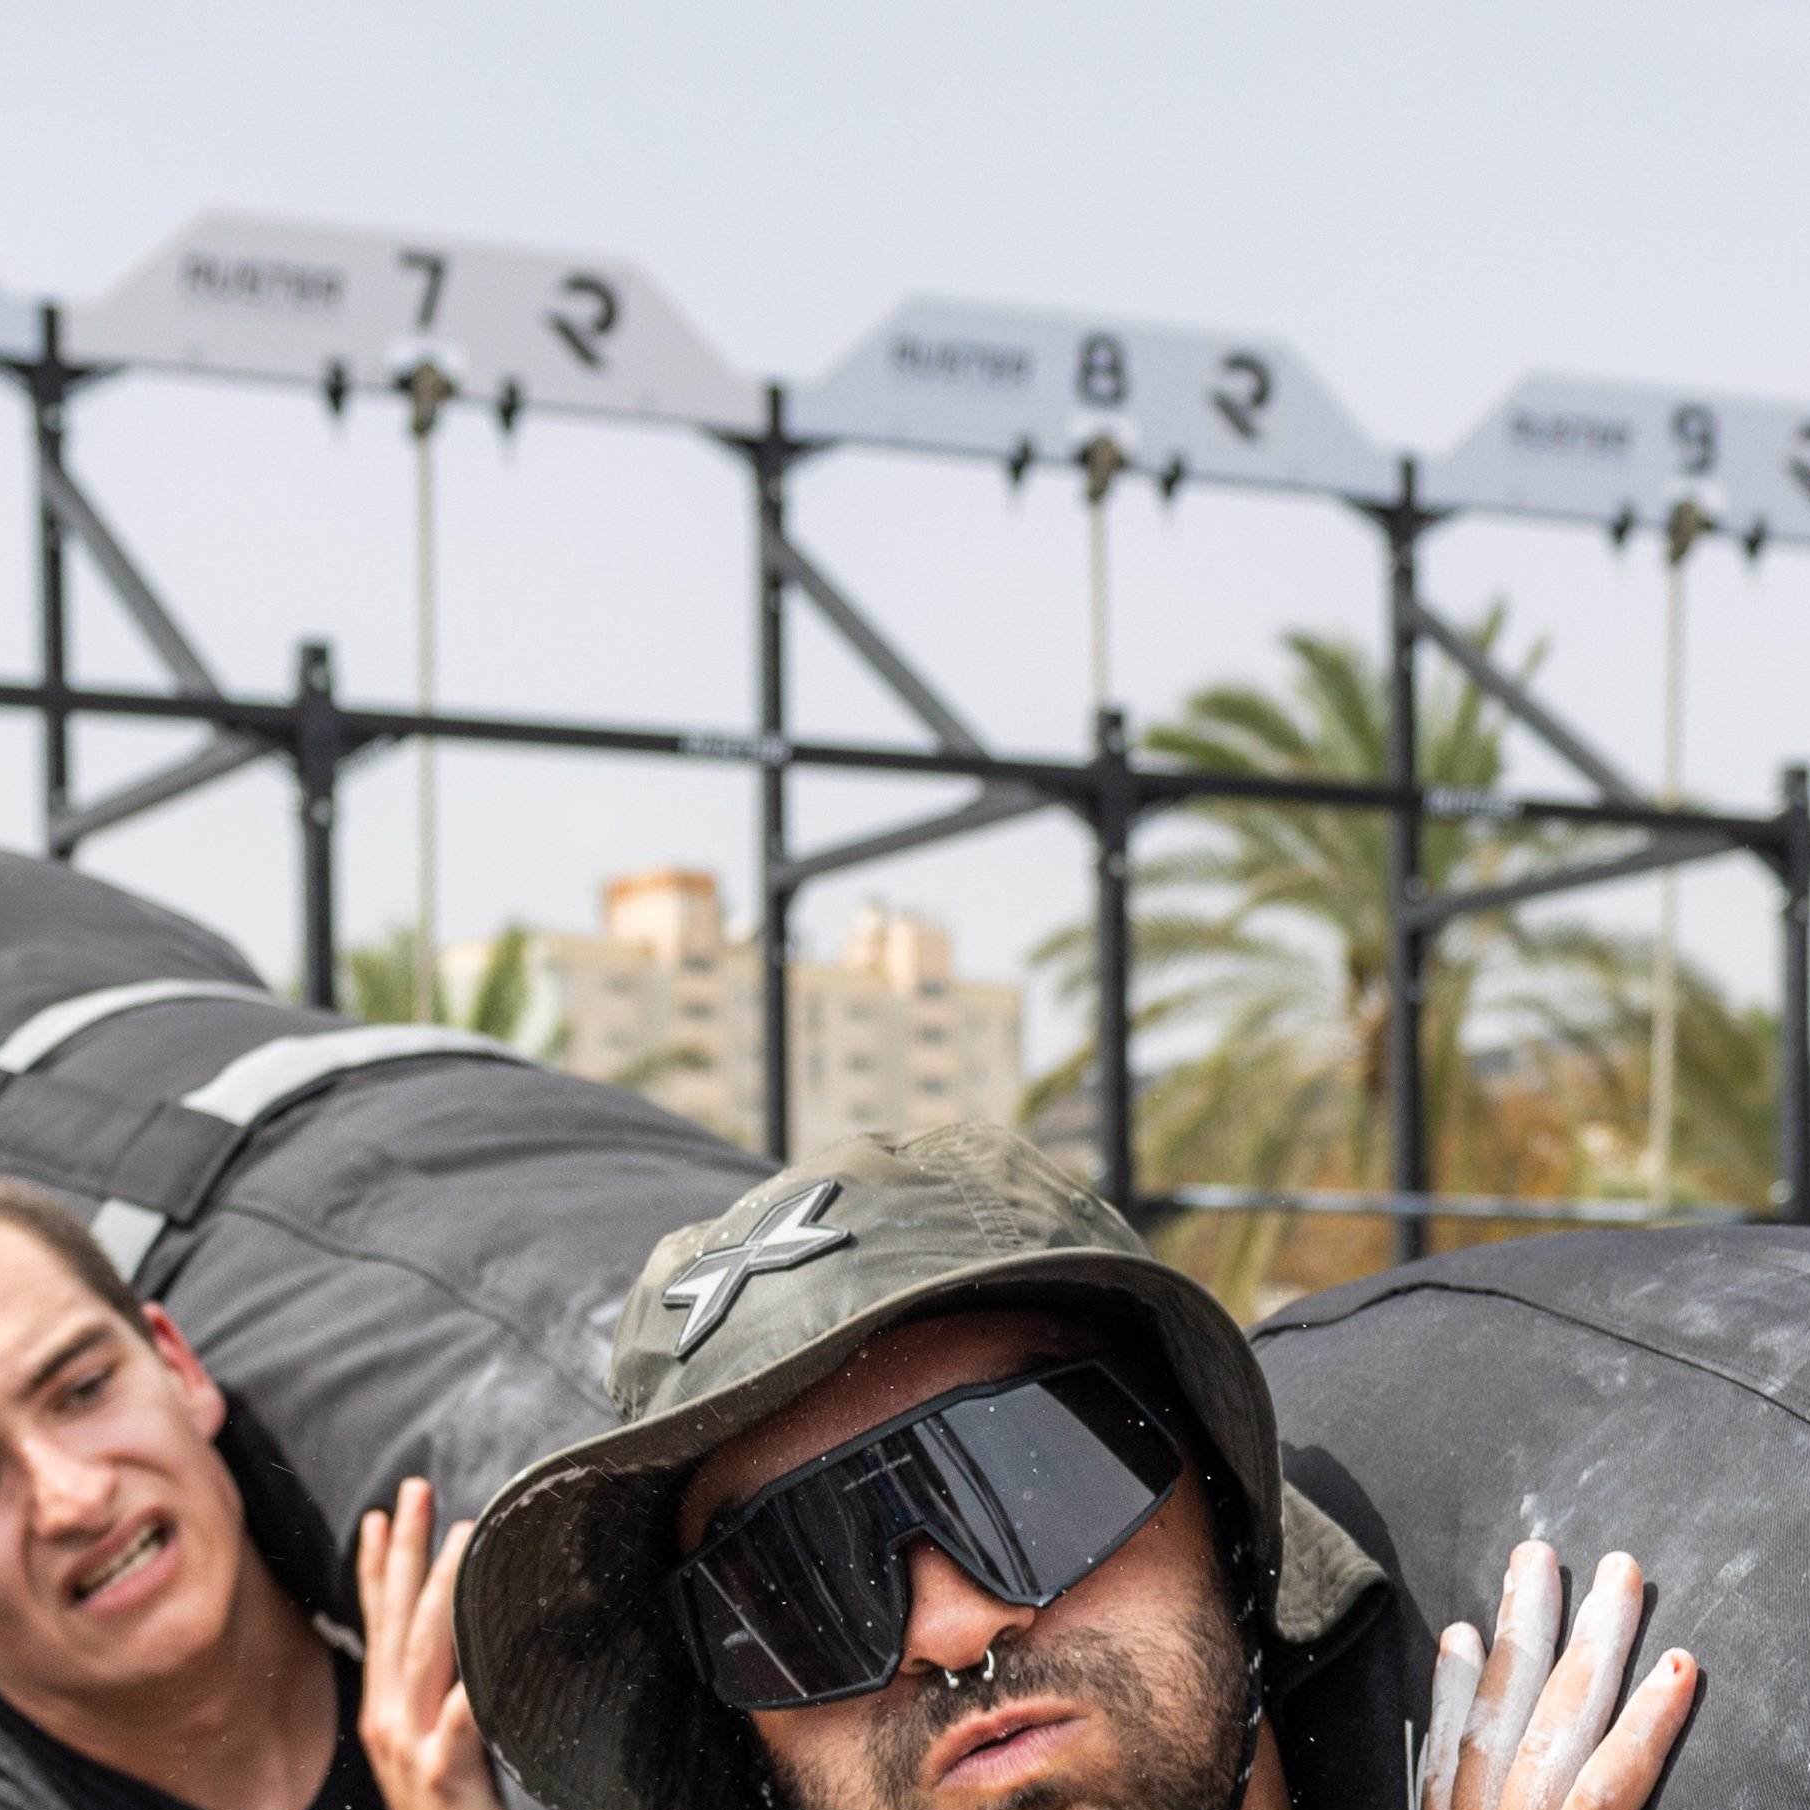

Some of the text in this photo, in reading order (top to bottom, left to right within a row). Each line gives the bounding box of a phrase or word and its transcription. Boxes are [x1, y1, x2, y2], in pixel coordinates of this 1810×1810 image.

[399, 251, 449, 330] 7
[1076, 335, 1129, 408] 8
[1670, 405, 1717, 476] 9
